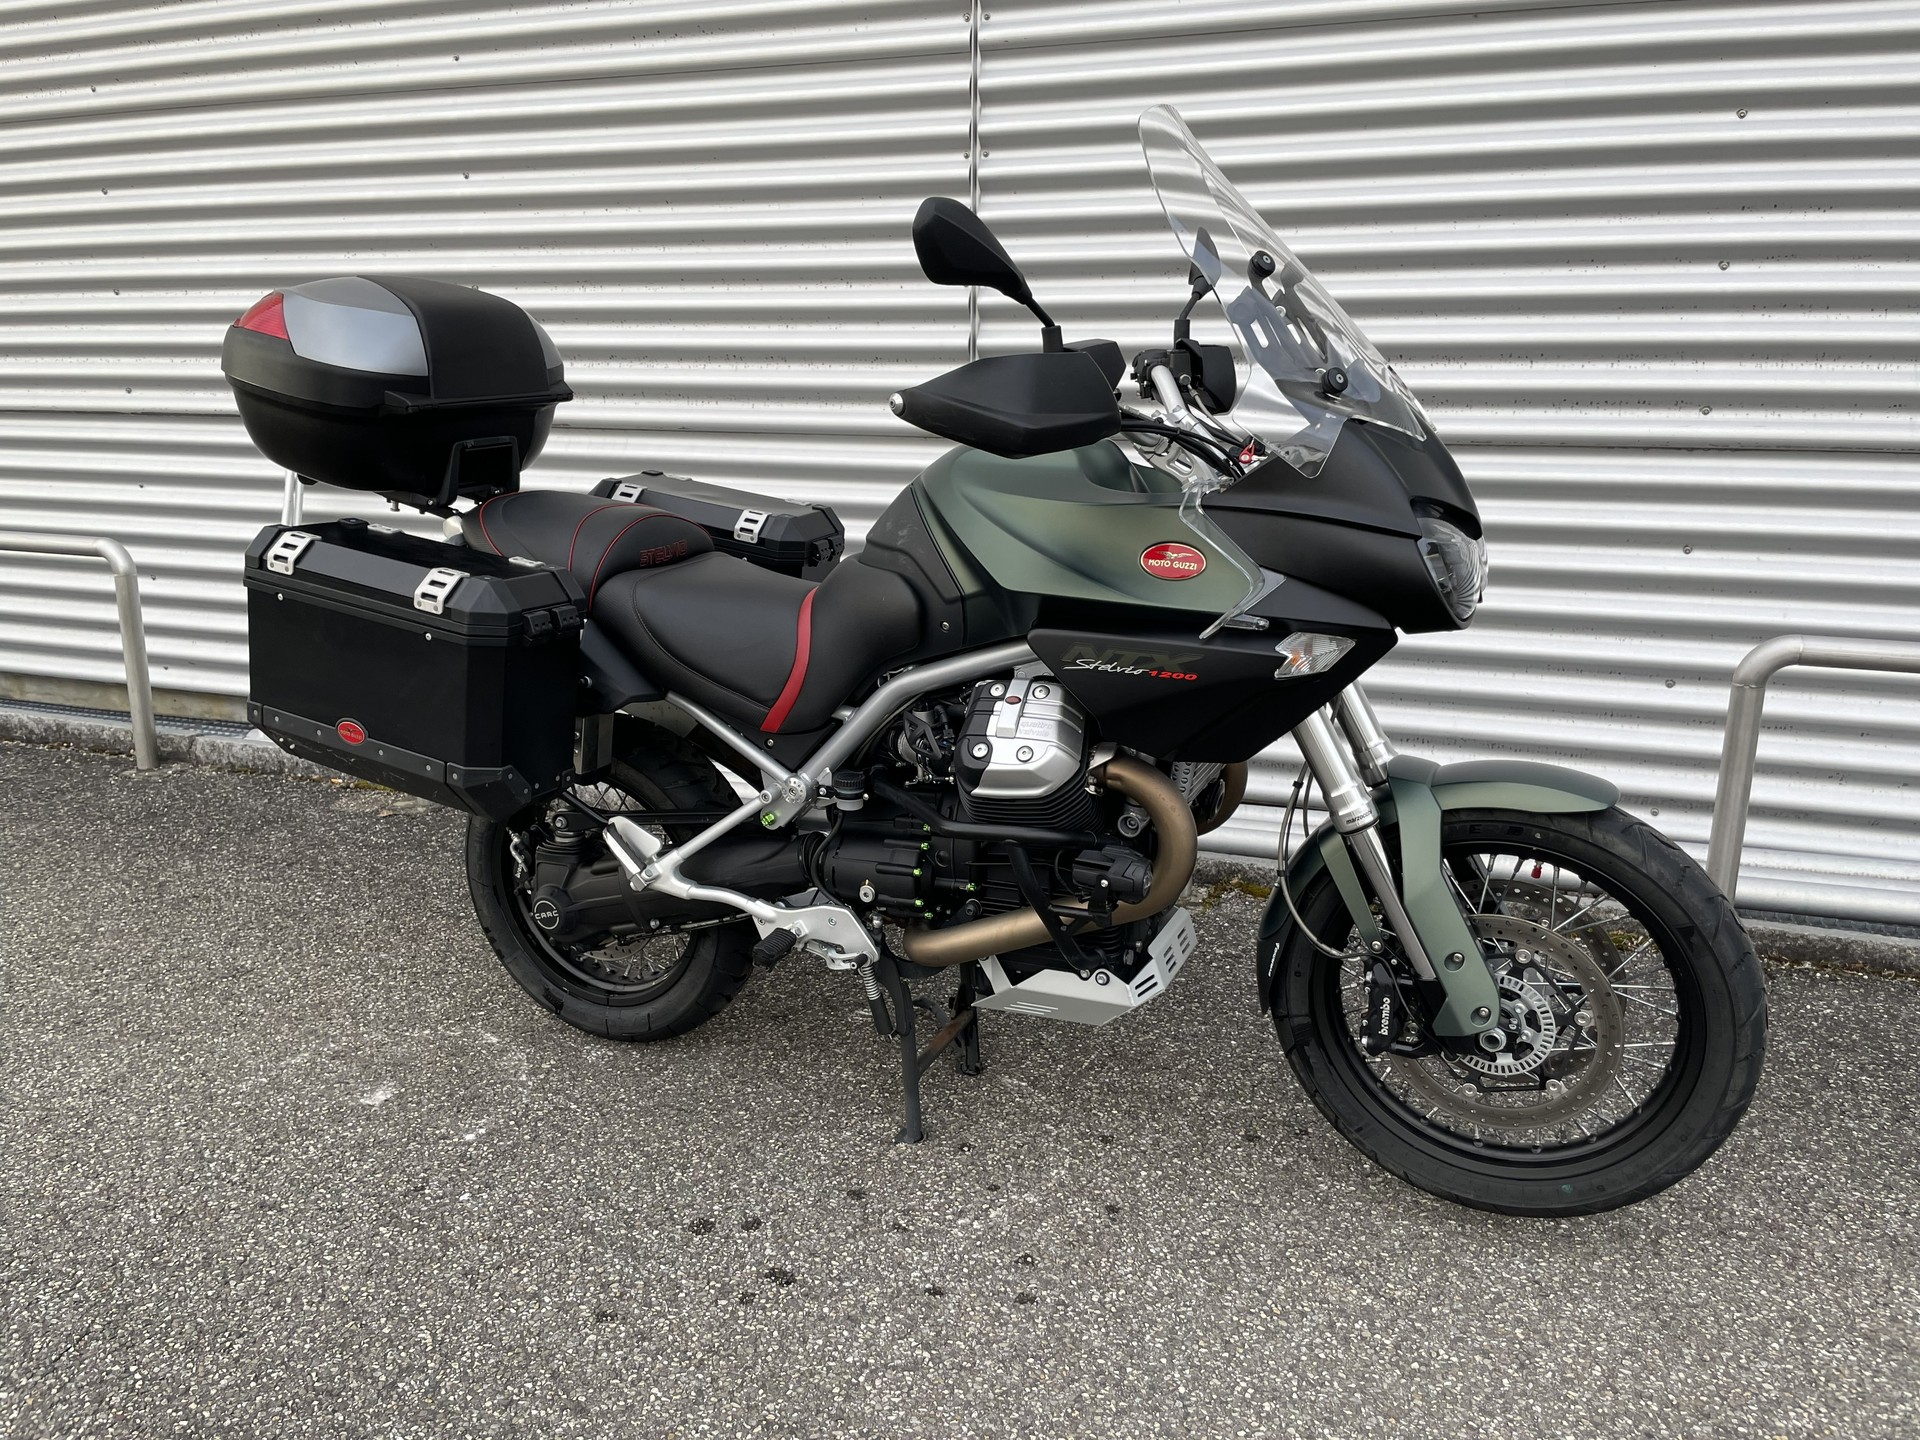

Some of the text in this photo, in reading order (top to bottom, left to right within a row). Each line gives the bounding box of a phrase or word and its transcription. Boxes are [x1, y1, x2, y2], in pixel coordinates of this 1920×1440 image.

[1148, 559, 1198, 571] MOTO GUZZI
[1061, 642, 1204, 672] NTX
[1063, 658, 1198, 681] Stelvio 1200
[535, 910, 559, 919] CARC
[1378, 997, 1390, 1036] brembo
